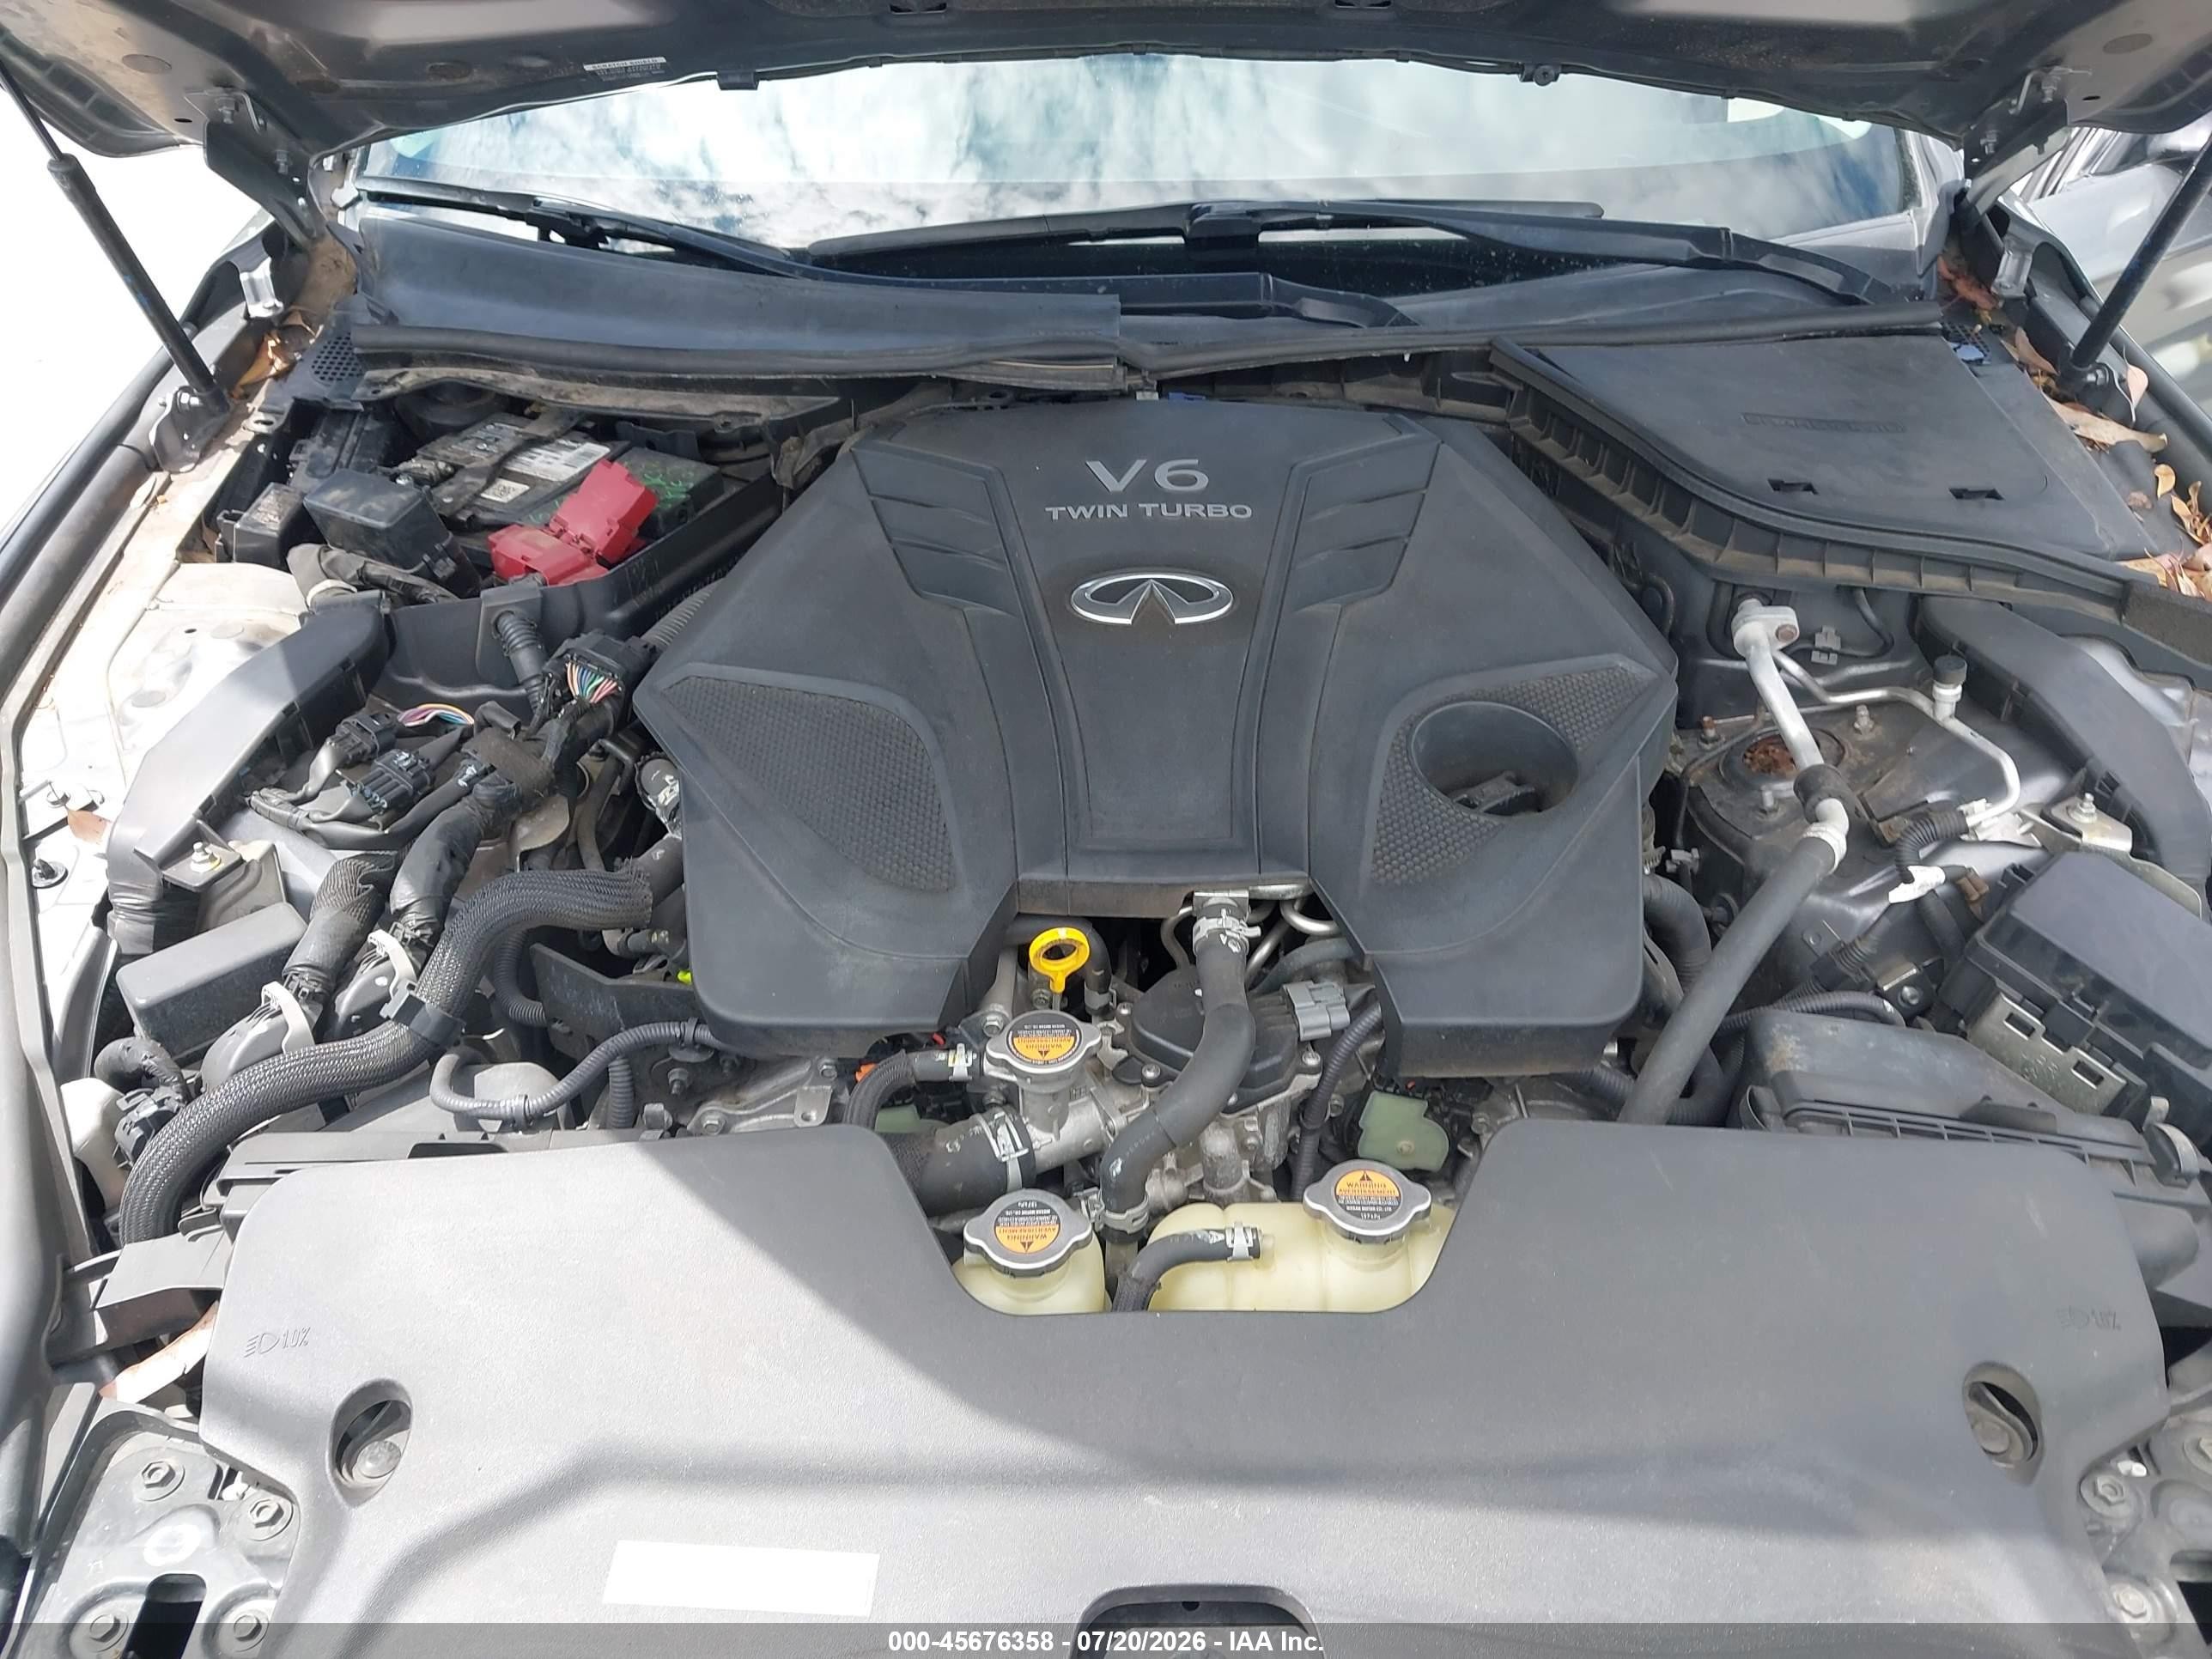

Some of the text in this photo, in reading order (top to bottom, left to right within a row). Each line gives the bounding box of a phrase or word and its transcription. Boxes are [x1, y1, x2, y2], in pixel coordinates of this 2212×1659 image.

[1085, 459, 1209, 493] V6
[1045, 503, 1252, 520] TWIN TURBO
